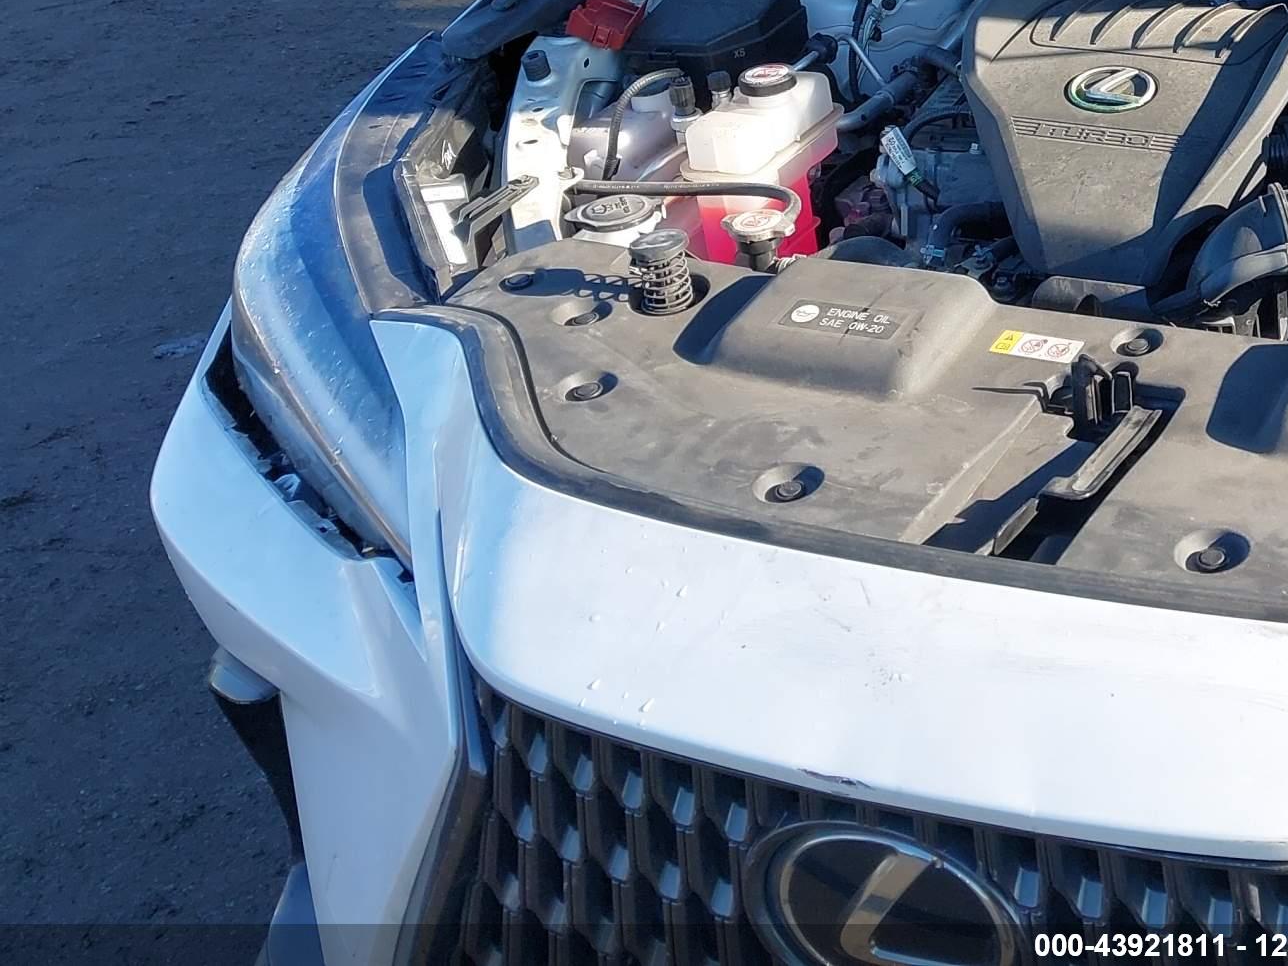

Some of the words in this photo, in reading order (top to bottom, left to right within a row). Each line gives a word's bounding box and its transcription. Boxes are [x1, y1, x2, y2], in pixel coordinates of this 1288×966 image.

[1042, 124, 1150, 146] TURBO
[826, 308, 869, 321] ENGINE
[873, 313, 891, 324] OIL
[819, 318, 843, 328] SAE
[848, 322, 884, 333] 0W-20
